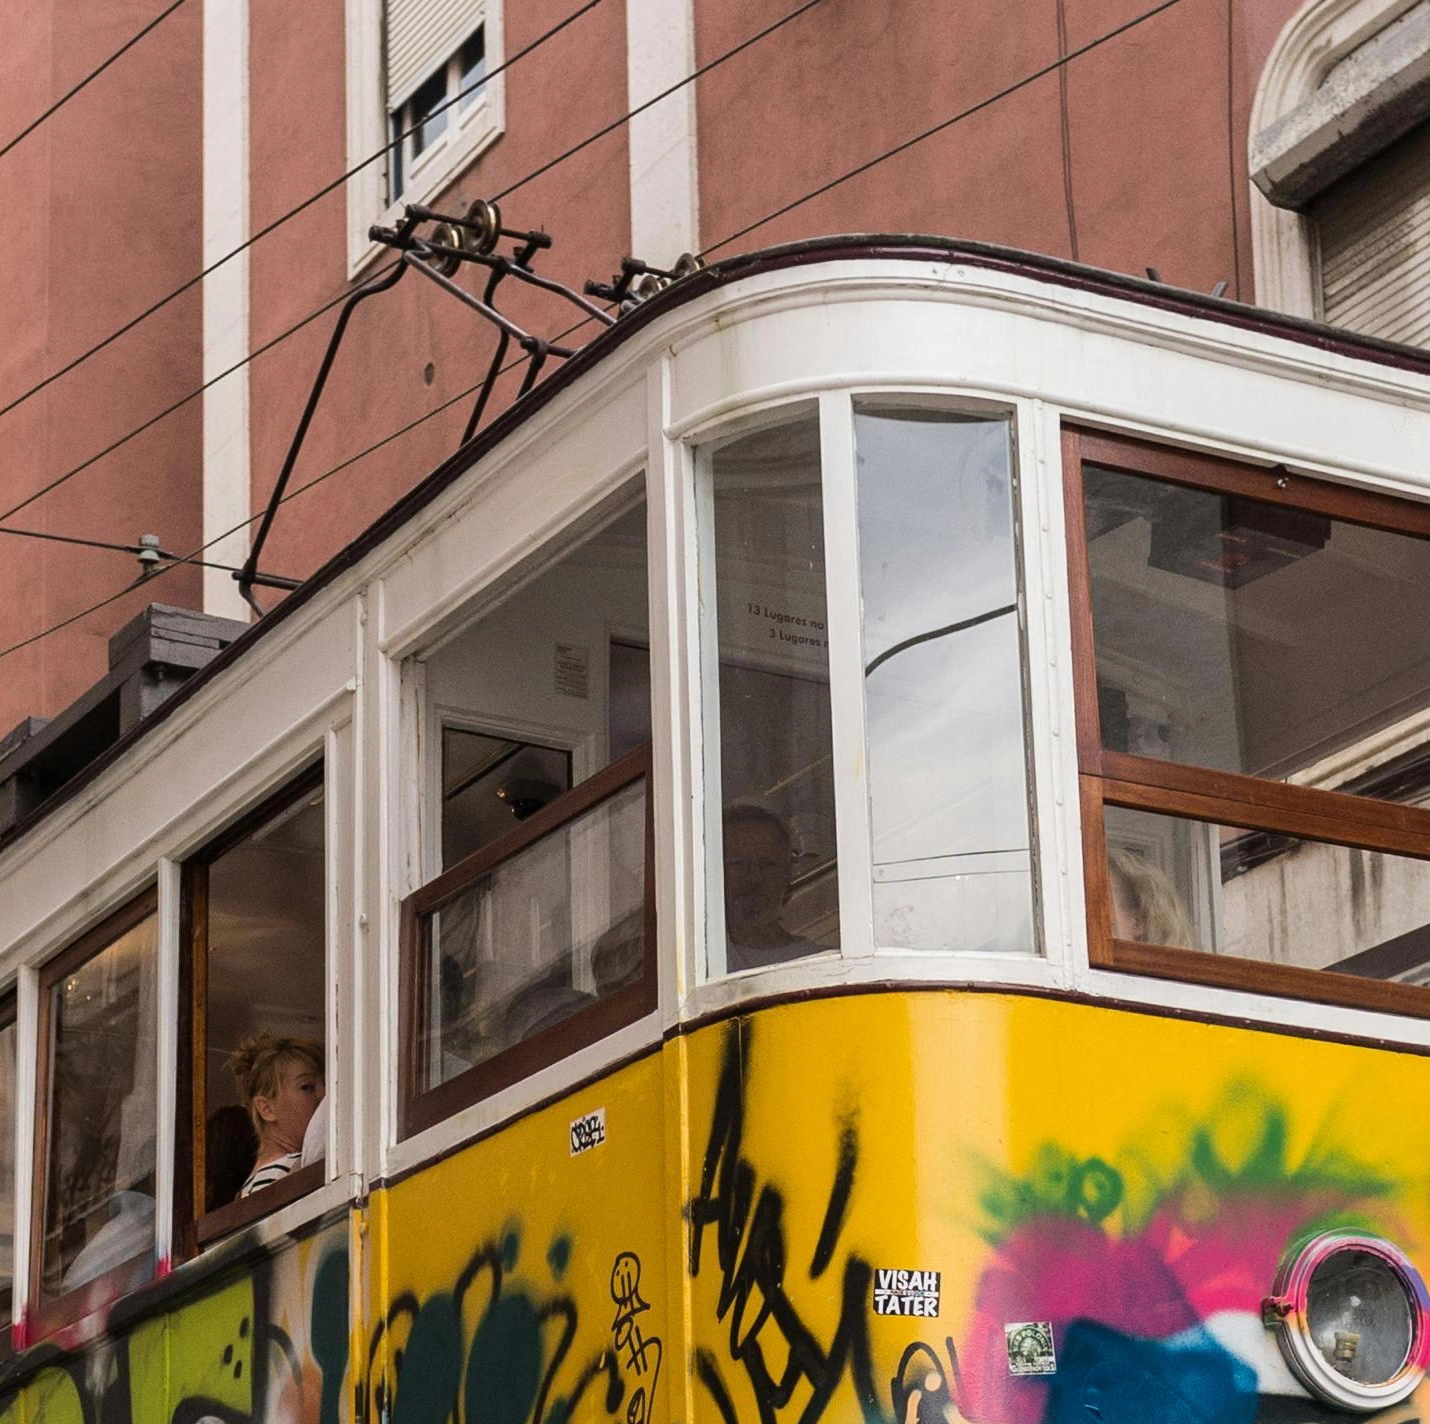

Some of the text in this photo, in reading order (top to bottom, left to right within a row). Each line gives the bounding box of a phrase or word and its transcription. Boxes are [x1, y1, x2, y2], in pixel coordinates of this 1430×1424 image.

[747, 603, 761, 616] 13
[764, 607, 807, 627] Lugares
[769, 628, 776, 639] 3
[779, 630, 821, 647] Lugares
[878, 1269, 938, 1292] VISAH
[874, 1295, 938, 1318] TATER
